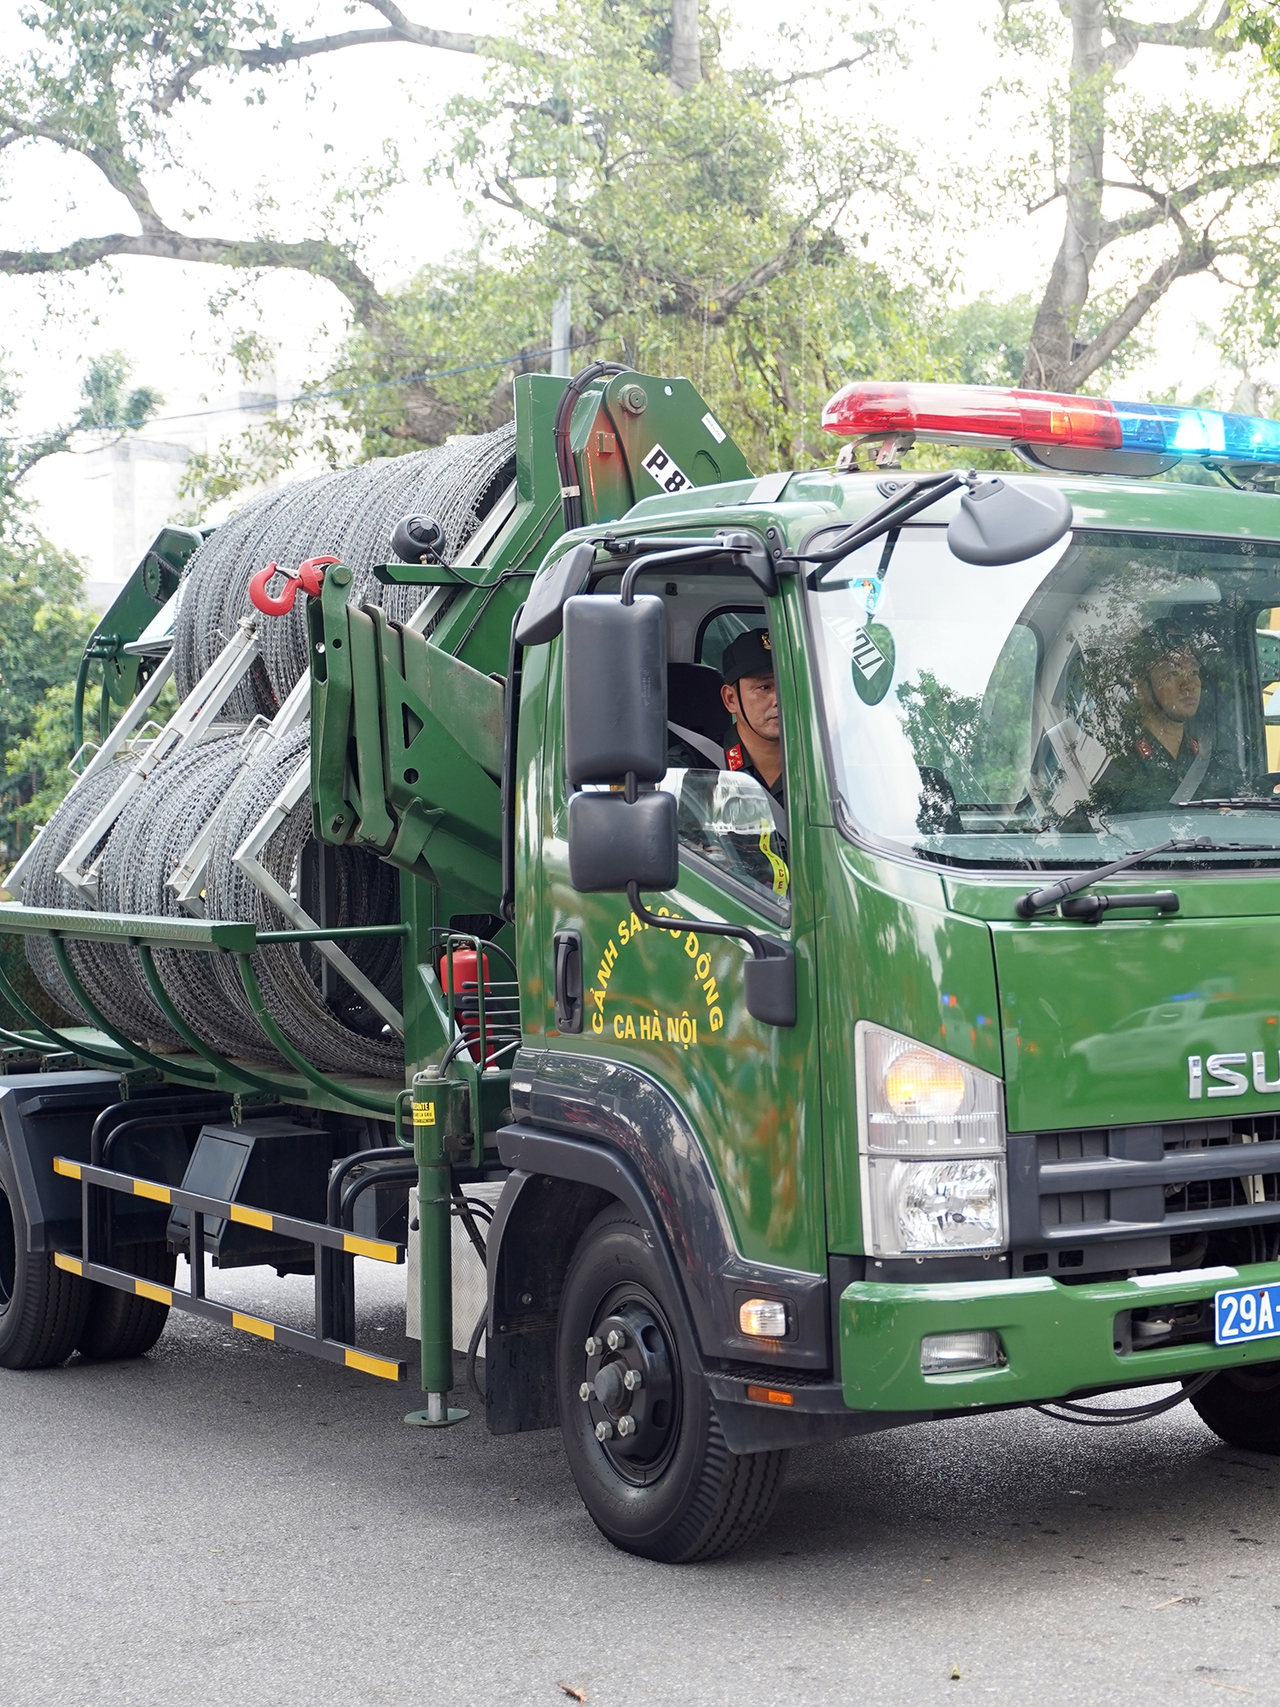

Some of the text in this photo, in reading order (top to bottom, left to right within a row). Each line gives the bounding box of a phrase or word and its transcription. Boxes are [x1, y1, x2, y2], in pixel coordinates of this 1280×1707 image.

[590, 939, 618, 1034] CẢNH
[684, 932, 723, 1032] ĐỘNG
[613, 1009, 697, 1050] CA HÀ NỘI
